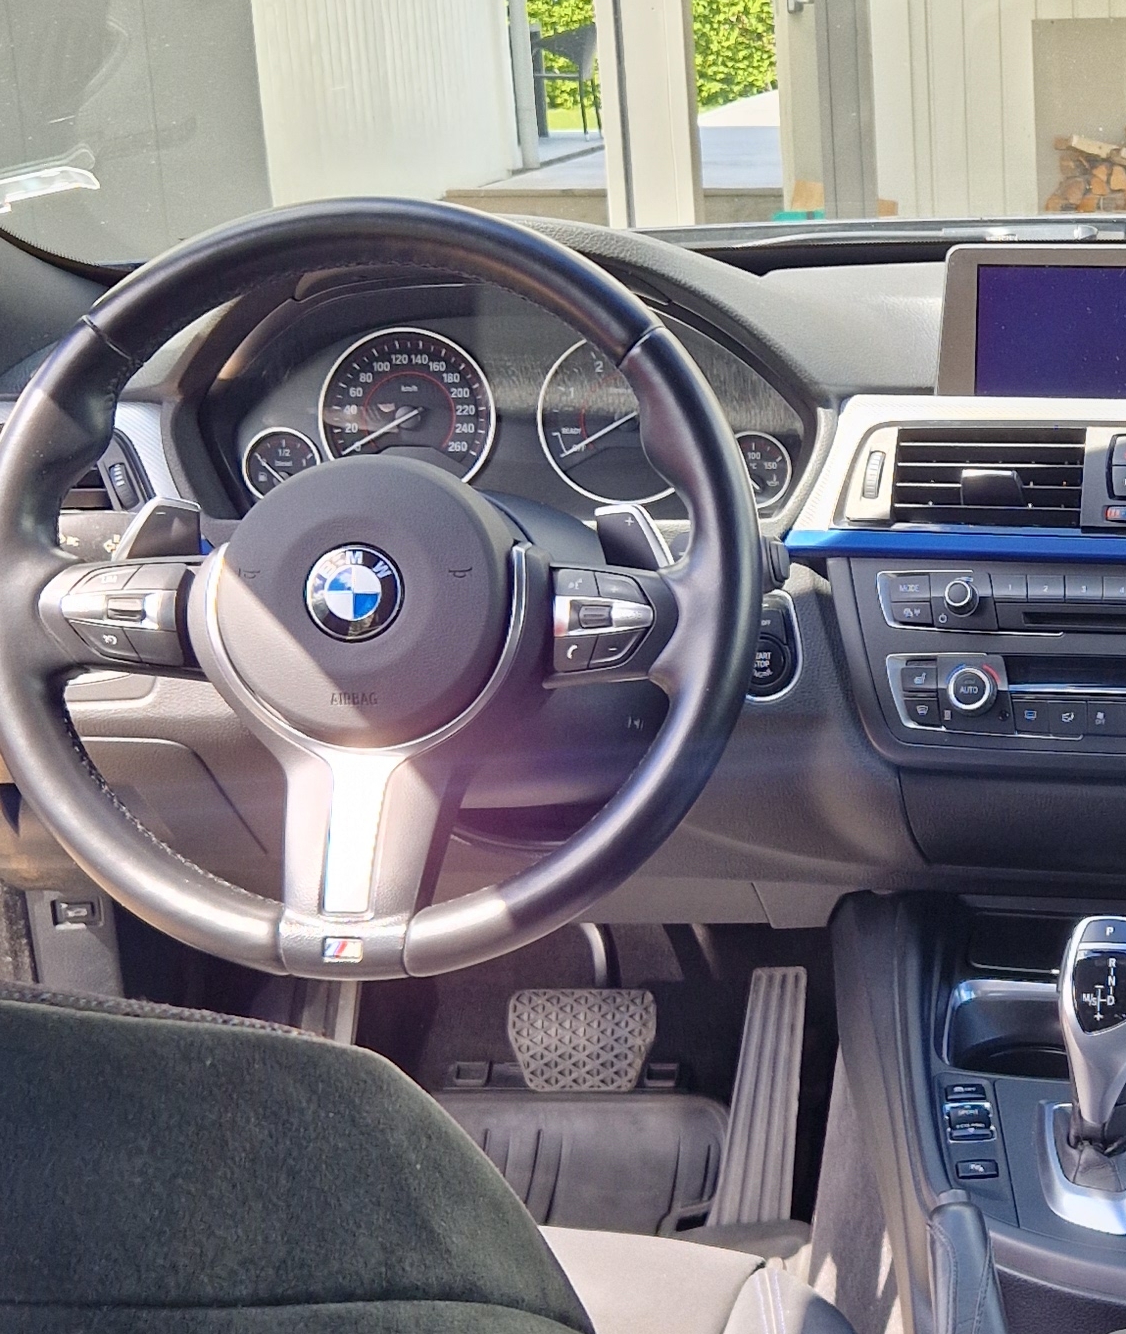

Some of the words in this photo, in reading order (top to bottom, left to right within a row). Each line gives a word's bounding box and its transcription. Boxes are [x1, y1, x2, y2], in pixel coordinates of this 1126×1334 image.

[391, 354, 409, 364] 120
[411, 354, 428, 365] 140
[373, 361, 391, 372] 100
[428, 361, 446, 372] 160
[594, 361, 604, 373] 2
[359, 373, 373, 383] 80
[442, 373, 460, 383] 180
[350, 387, 363, 397] 60
[451, 387, 470, 398] 200
[343, 405, 357, 415] 40
[456, 405, 475, 415] 220
[345, 423, 358, 433] 20
[455, 423, 475, 433] 240
[448, 442, 468, 452] 260
[277, 448, 291, 457] 1/2
[747, 452, 761, 460] 100
[763, 462, 778, 470] 150
[319, 550, 393, 580] BMW
[899, 583, 920, 593] MODE
[959, 686, 979, 694] AUTO
[330, 692, 378, 706] AIRBAG
[1105, 926, 1114, 936] P
[1108, 958, 1117, 968] R
[1107, 976, 1116, 986] N
[1106, 996, 1115, 1006] D
